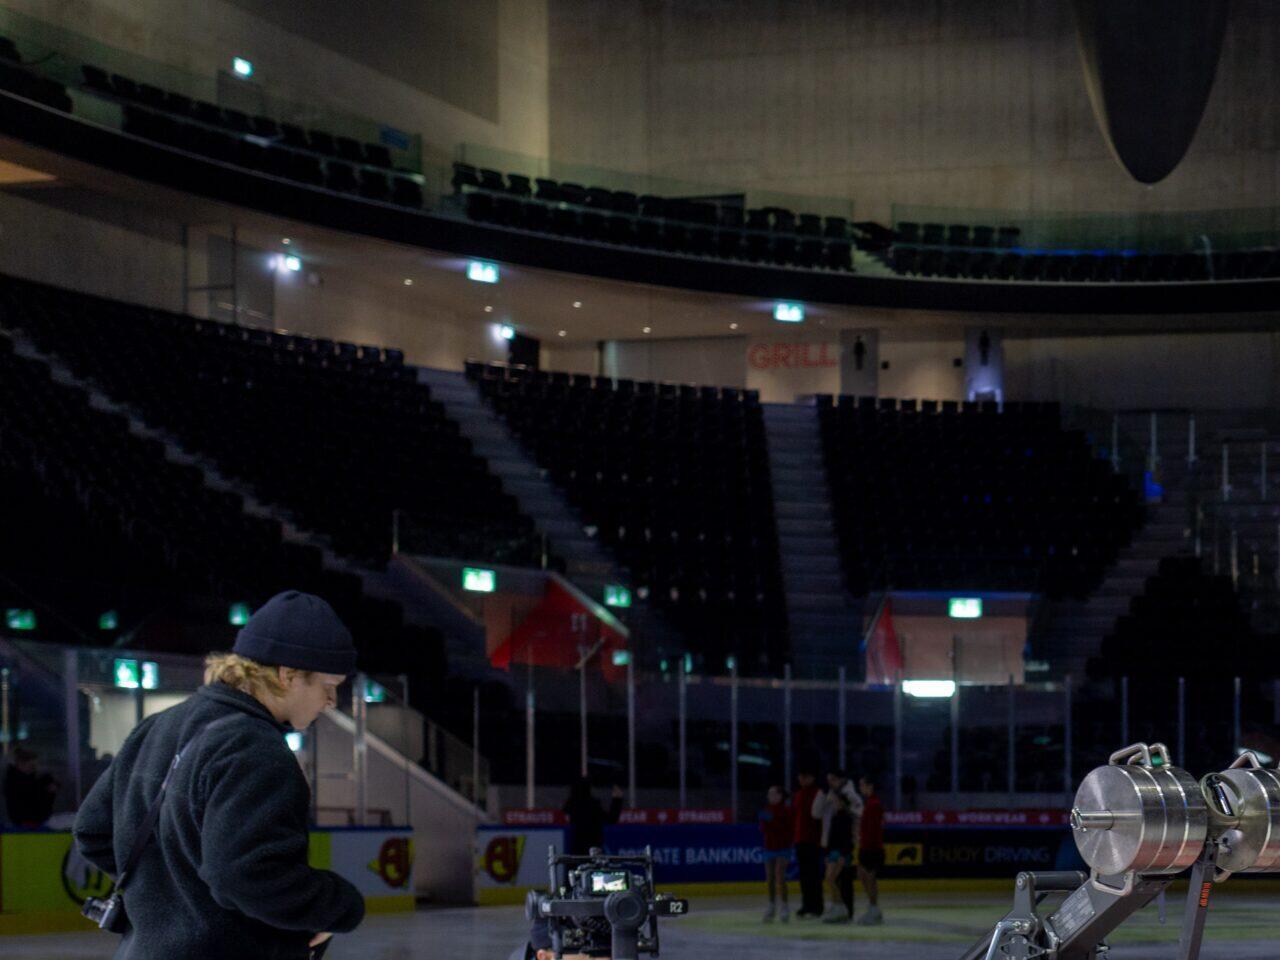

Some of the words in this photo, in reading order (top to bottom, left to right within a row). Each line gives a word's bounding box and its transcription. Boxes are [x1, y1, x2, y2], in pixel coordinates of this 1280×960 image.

[748, 342, 837, 370] GRILL
[685, 846, 764, 865] BANKING
[984, 846, 1051, 863] DRIVING
